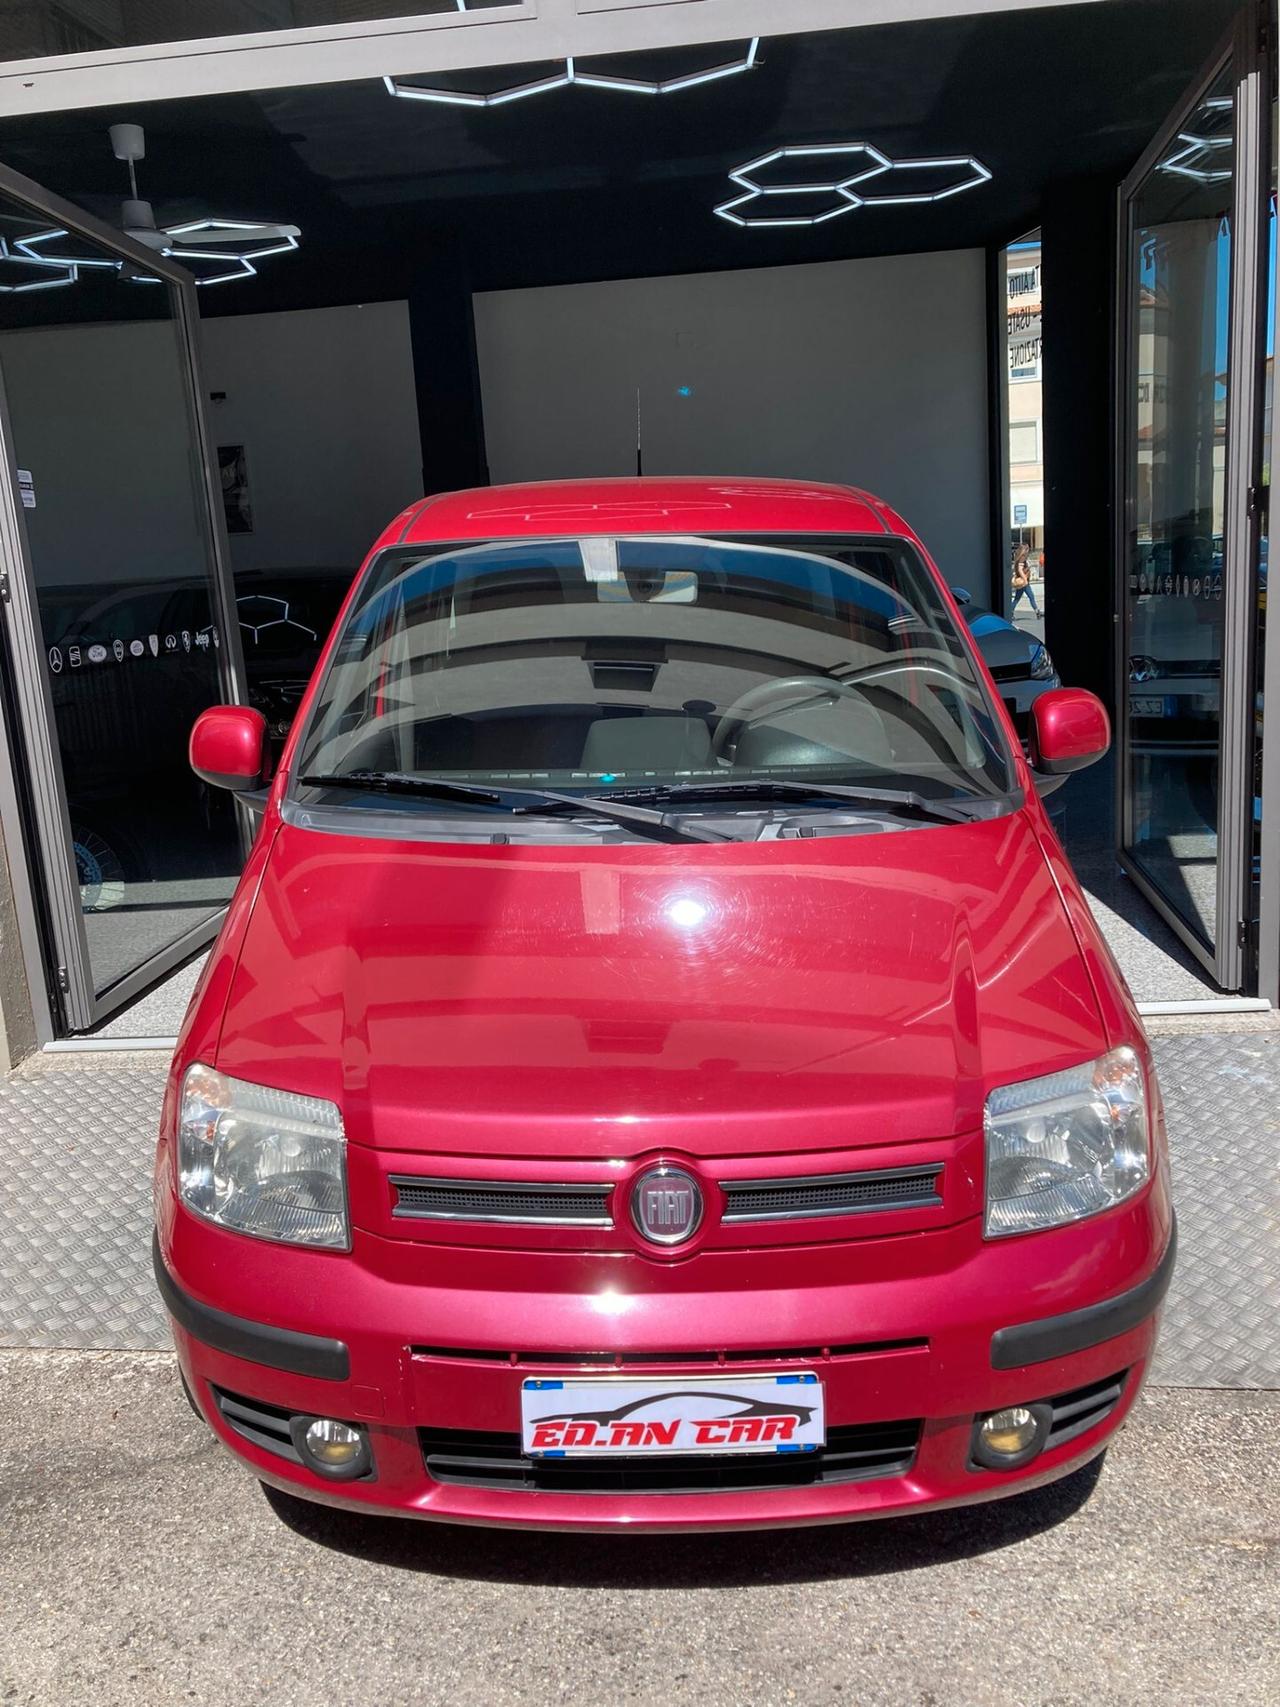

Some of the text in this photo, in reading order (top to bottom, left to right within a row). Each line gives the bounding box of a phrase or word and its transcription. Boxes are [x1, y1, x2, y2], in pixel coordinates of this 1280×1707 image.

[648, 1190, 689, 1224] FIAT
[531, 1417, 797, 1447] ED.AN CAR
